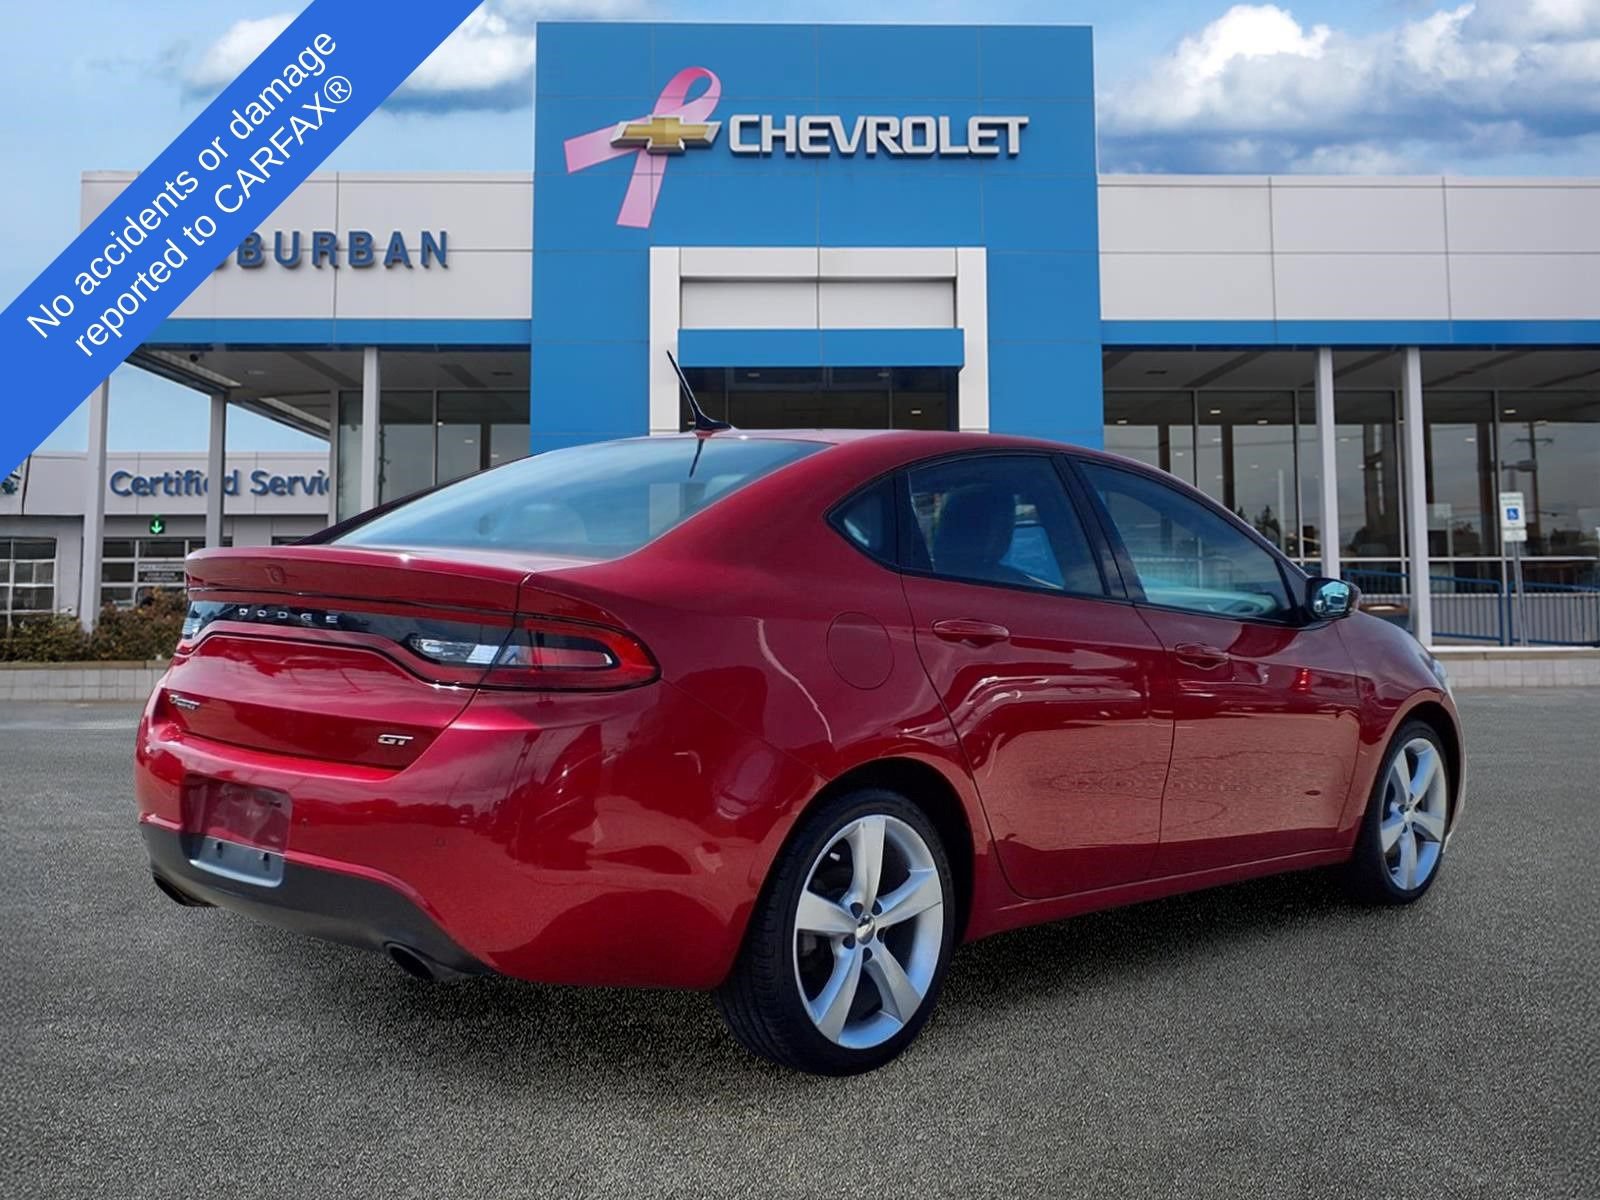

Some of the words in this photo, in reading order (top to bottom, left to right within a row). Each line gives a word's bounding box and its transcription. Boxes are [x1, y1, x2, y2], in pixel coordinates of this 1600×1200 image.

[729, 114, 1029, 156] CHEVROLET
[216, 230, 448, 269] BURBAN
[239, 607, 338, 624] DODGE
[378, 734, 414, 746] GT
